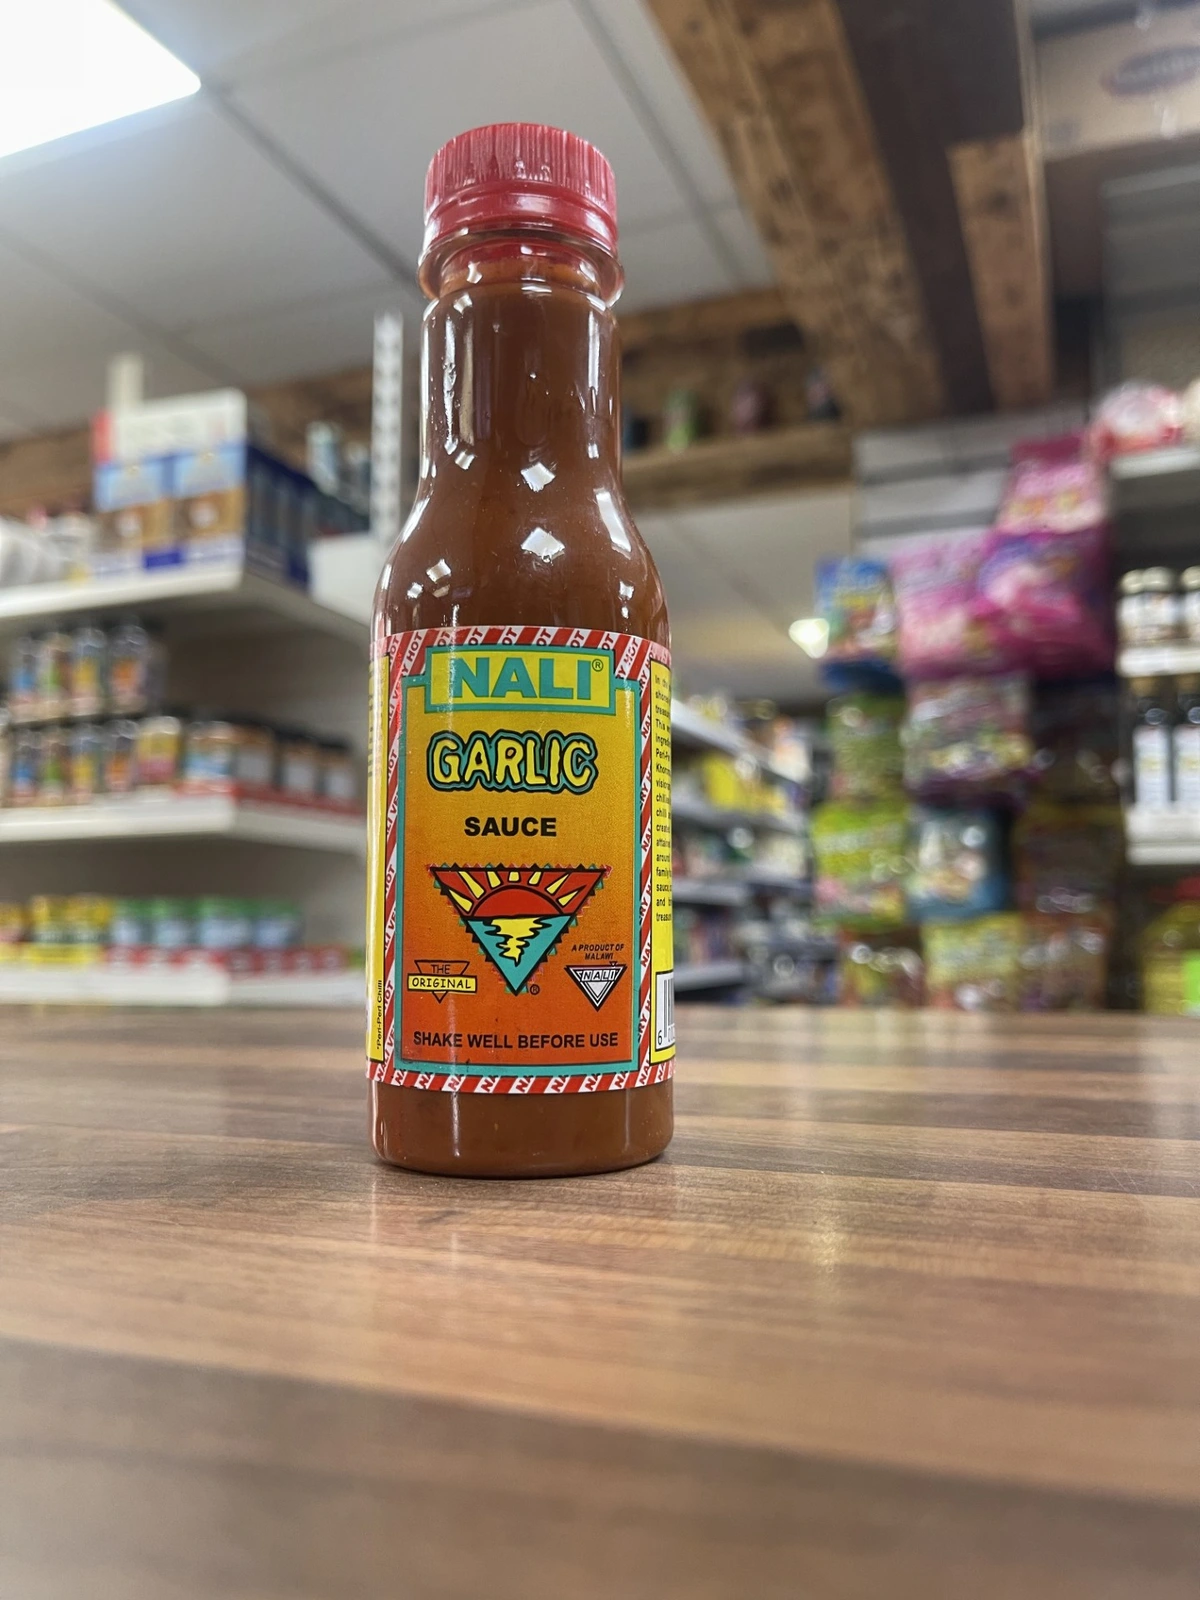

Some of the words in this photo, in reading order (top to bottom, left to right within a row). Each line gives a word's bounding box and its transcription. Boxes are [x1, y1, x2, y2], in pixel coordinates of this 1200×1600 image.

[429, 734, 596, 791] GARLIC
[464, 816, 557, 837] SAUCE
[656, 897, 666, 907] and
[571, 944, 577, 952] A
[578, 943, 614, 952] PRODUCT
[615, 943, 624, 951] OF
[584, 952, 614, 960] MALAWI
[431, 964, 451, 974] THE
[582, 969, 616, 981] NALI
[412, 977, 471, 989] ORIGINAL
[413, 1030, 463, 1047] SHAKE
[467, 1034, 513, 1049] WELL
[517, 1034, 586, 1049] BEFORE
[589, 1032, 618, 1047] USE
